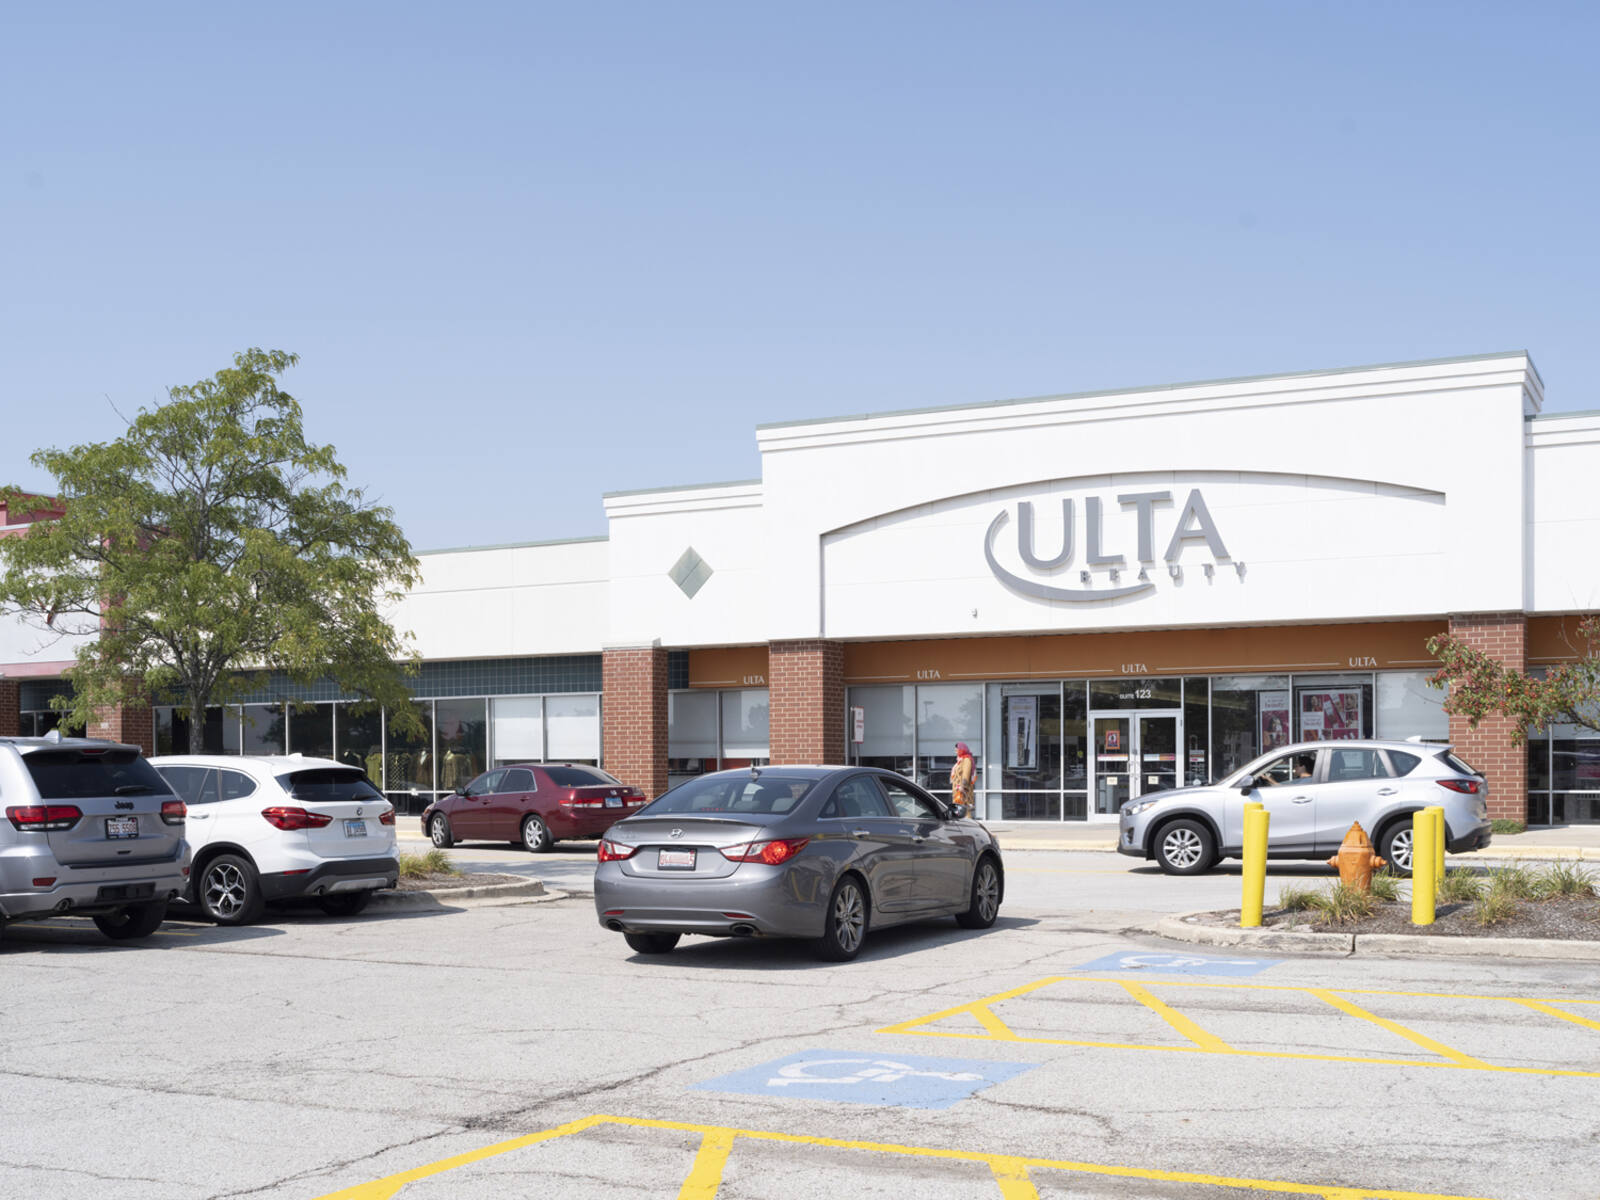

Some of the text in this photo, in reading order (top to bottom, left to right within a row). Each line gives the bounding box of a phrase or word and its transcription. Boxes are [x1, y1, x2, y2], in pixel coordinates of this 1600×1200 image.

[1017, 488, 1231, 570] ULTA
[1080, 562, 1247, 584] BEAUTY
[1349, 656, 1377, 667] ULTA
[1121, 663, 1148, 674] ULTA
[743, 675, 765, 685] ULTA
[917, 669, 941, 680] ULTA
[1135, 689, 1152, 699] 123
